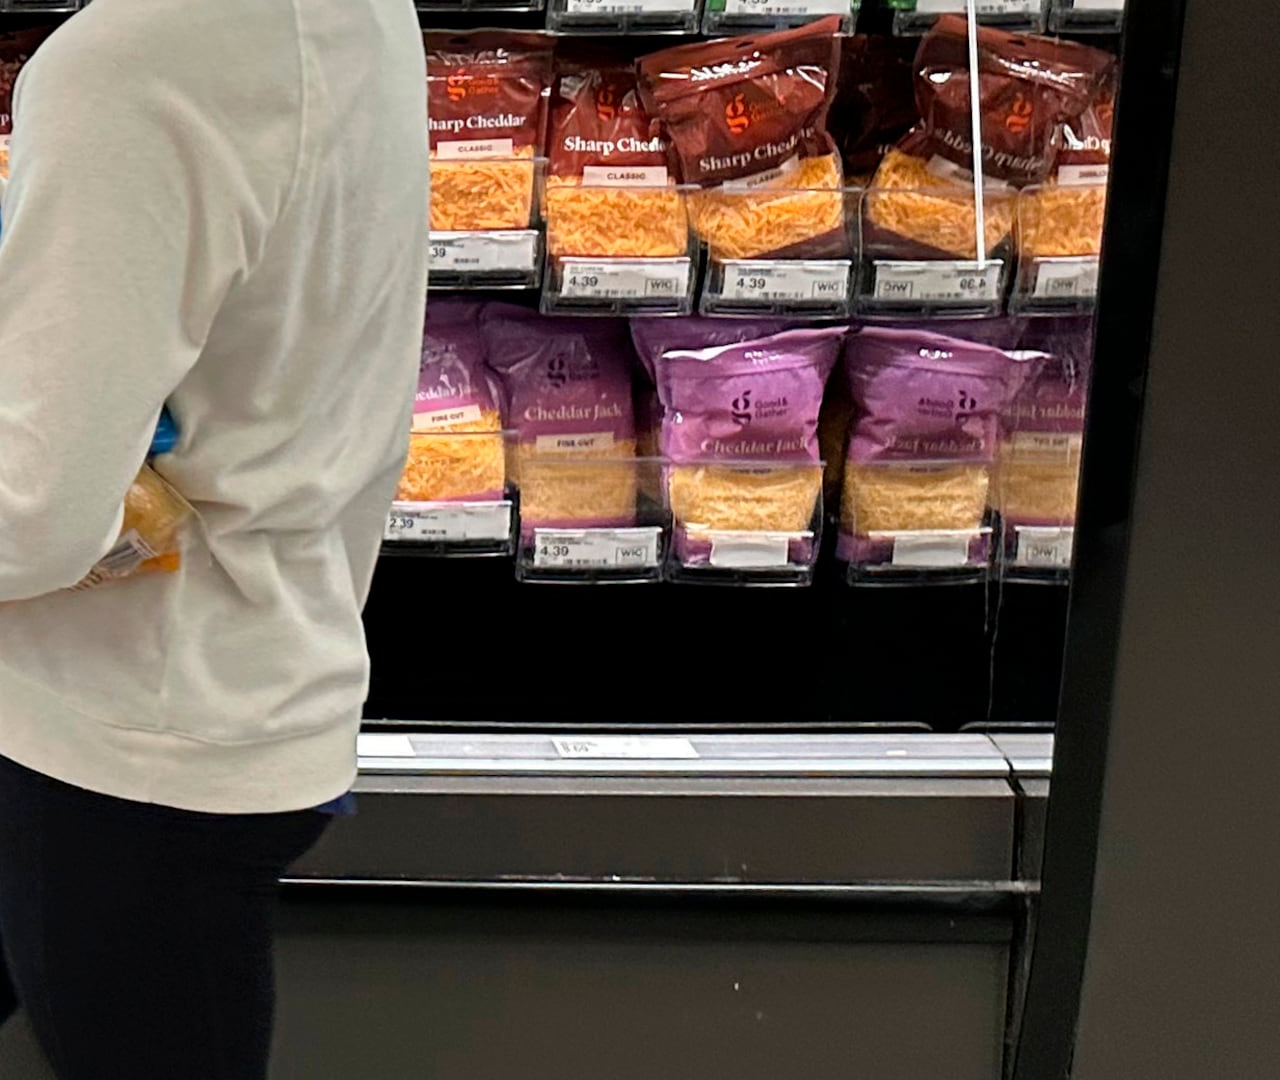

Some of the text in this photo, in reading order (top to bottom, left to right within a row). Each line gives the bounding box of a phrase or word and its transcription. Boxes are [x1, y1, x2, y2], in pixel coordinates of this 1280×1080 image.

[699, 152, 751, 173] Sharp
[607, 171, 646, 181] CLASSIC
[568, 275, 598, 288] 4.39
[818, 281, 840, 293] WIC
[524, 402, 622, 421] Cheddar Jack
[700, 436, 808, 454] Cheddar Jack
[540, 545, 569, 558] 4.39
